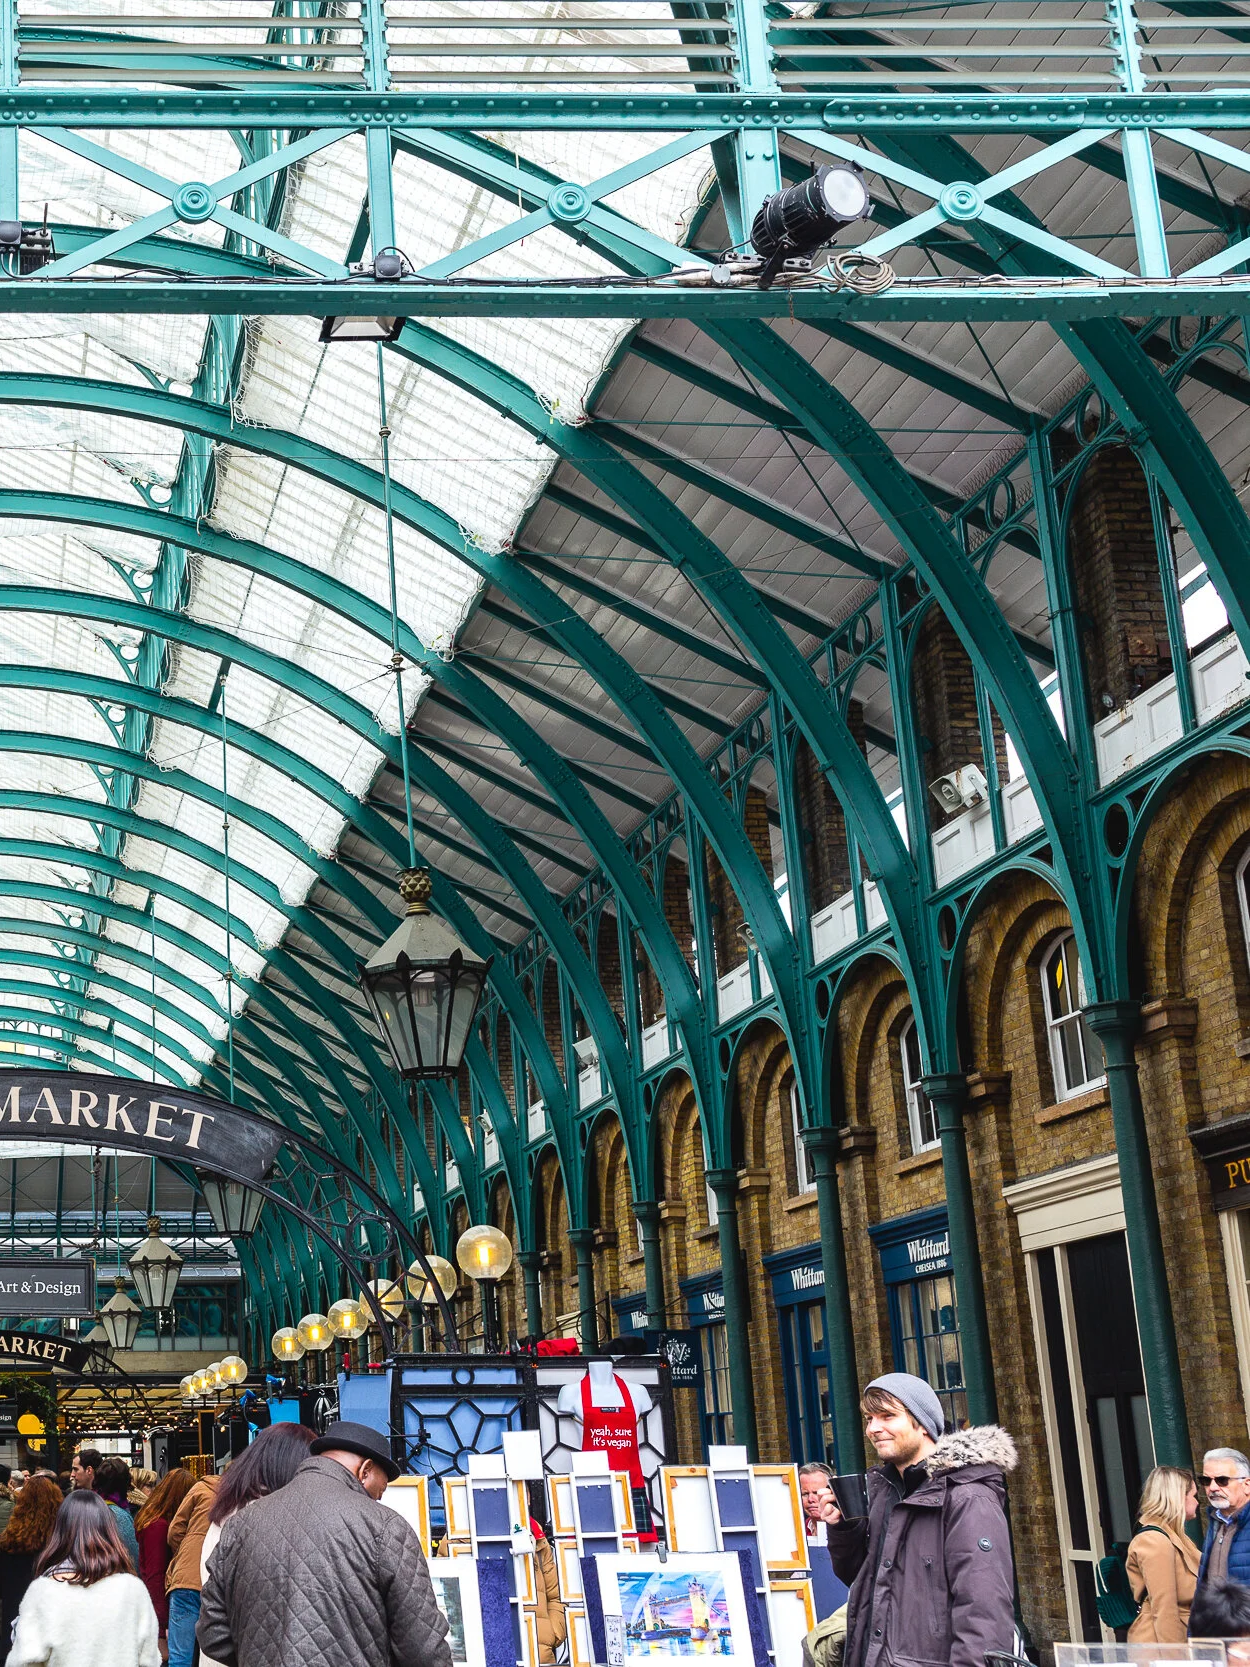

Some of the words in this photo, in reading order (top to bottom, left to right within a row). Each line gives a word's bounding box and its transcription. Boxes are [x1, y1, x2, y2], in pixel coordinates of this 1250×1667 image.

[907, 1232, 950, 1263] Whittard
[916, 1262, 937, 1274] CHELSEA
[791, 1267, 825, 1291] Whittar
[21, 1282, 32, 1294] &
[34, 1281, 82, 1296] Design
[672, 1364, 698, 1375] ttard
[590, 1425, 613, 1439] yeah,
[614, 1429, 632, 1437] sure
[593, 1437, 606, 1446] it's
[607, 1439, 632, 1450] vegan
